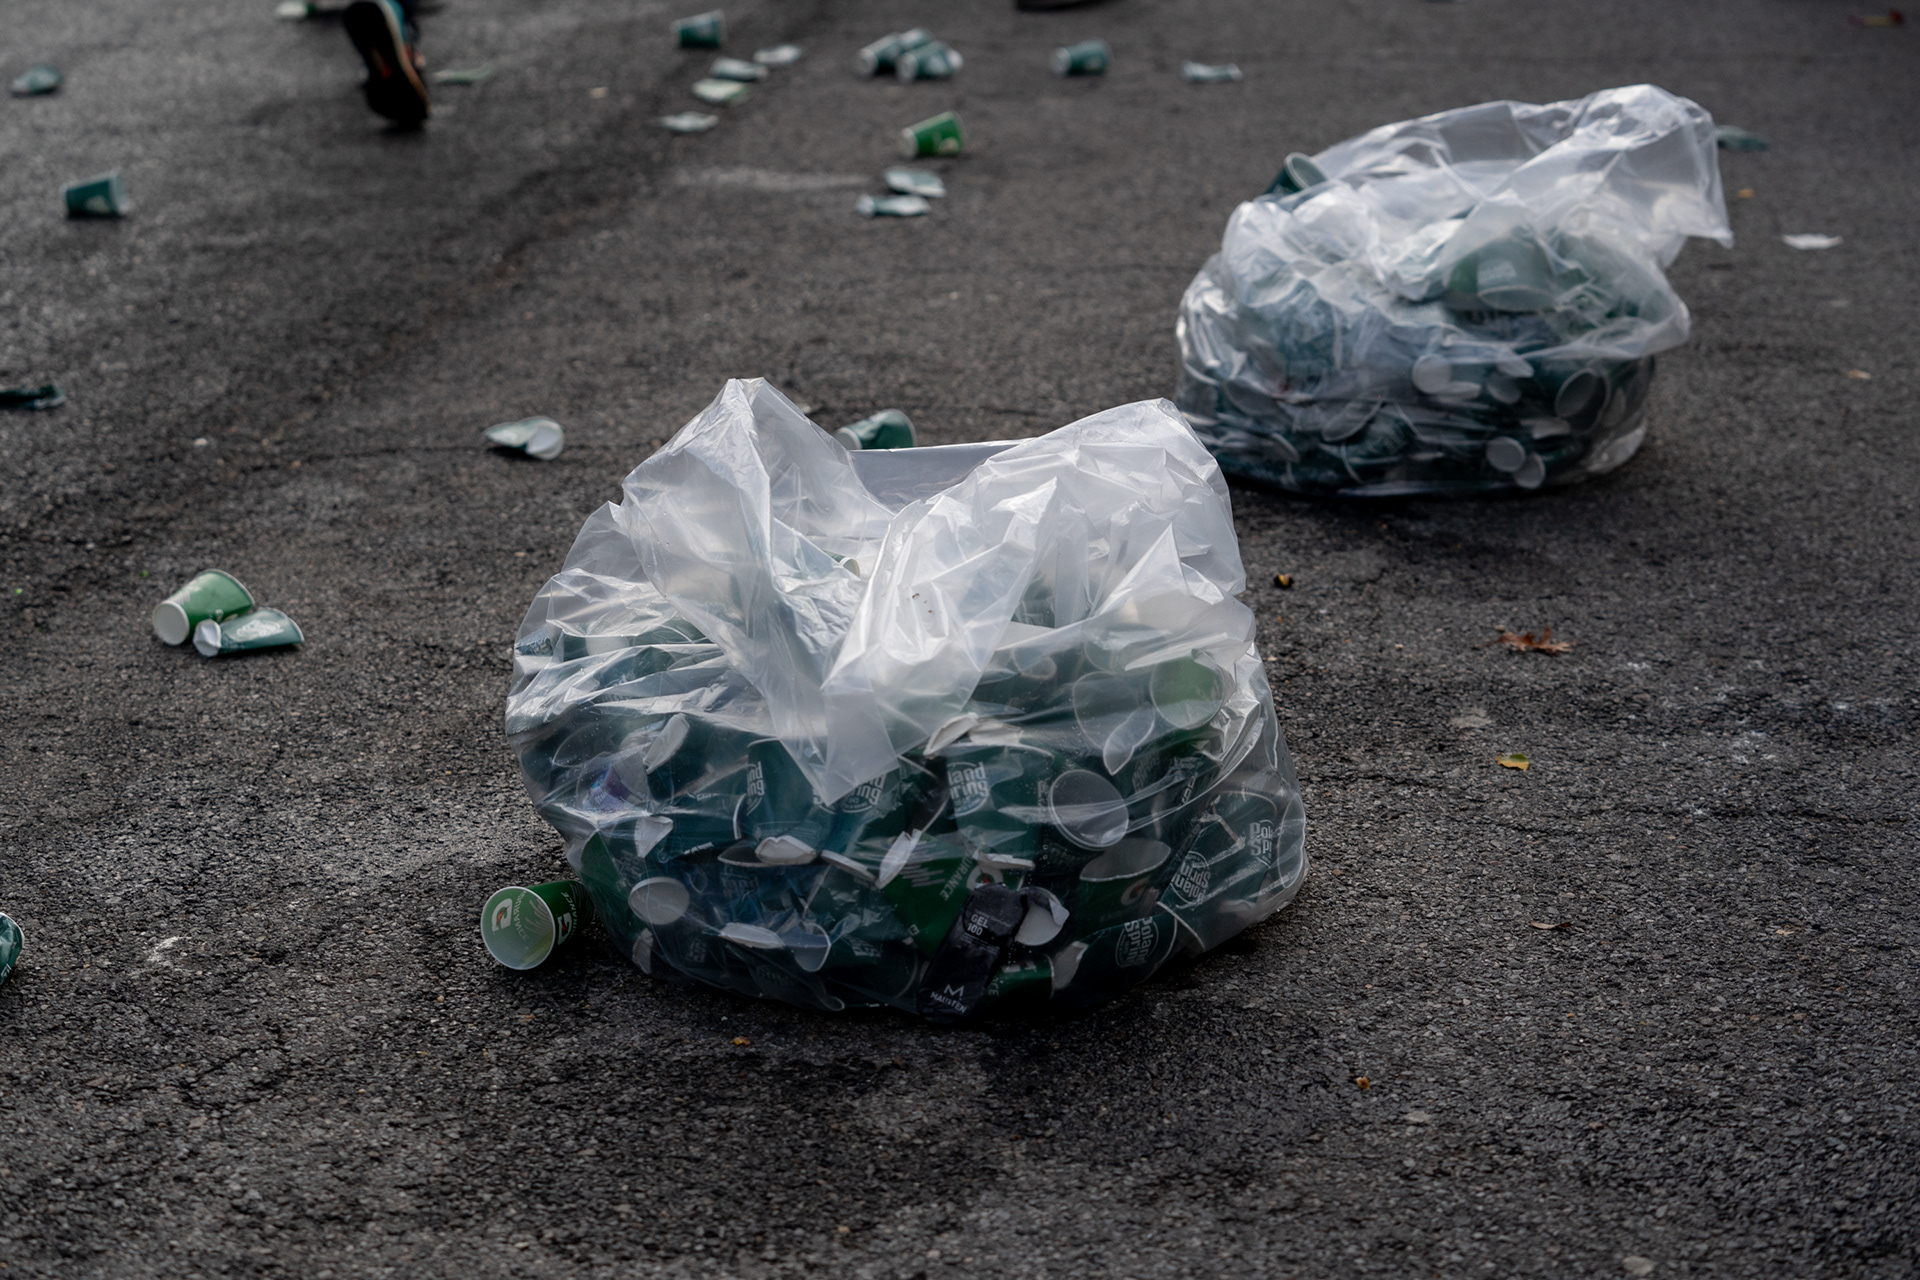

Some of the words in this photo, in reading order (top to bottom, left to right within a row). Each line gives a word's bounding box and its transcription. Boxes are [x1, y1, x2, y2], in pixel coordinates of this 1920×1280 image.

[947, 761, 987, 785] land
[949, 778, 990, 801] ring
[939, 856, 975, 901] URANCE
[966, 923, 984, 936] 100
[970, 913, 989, 929] GEL
